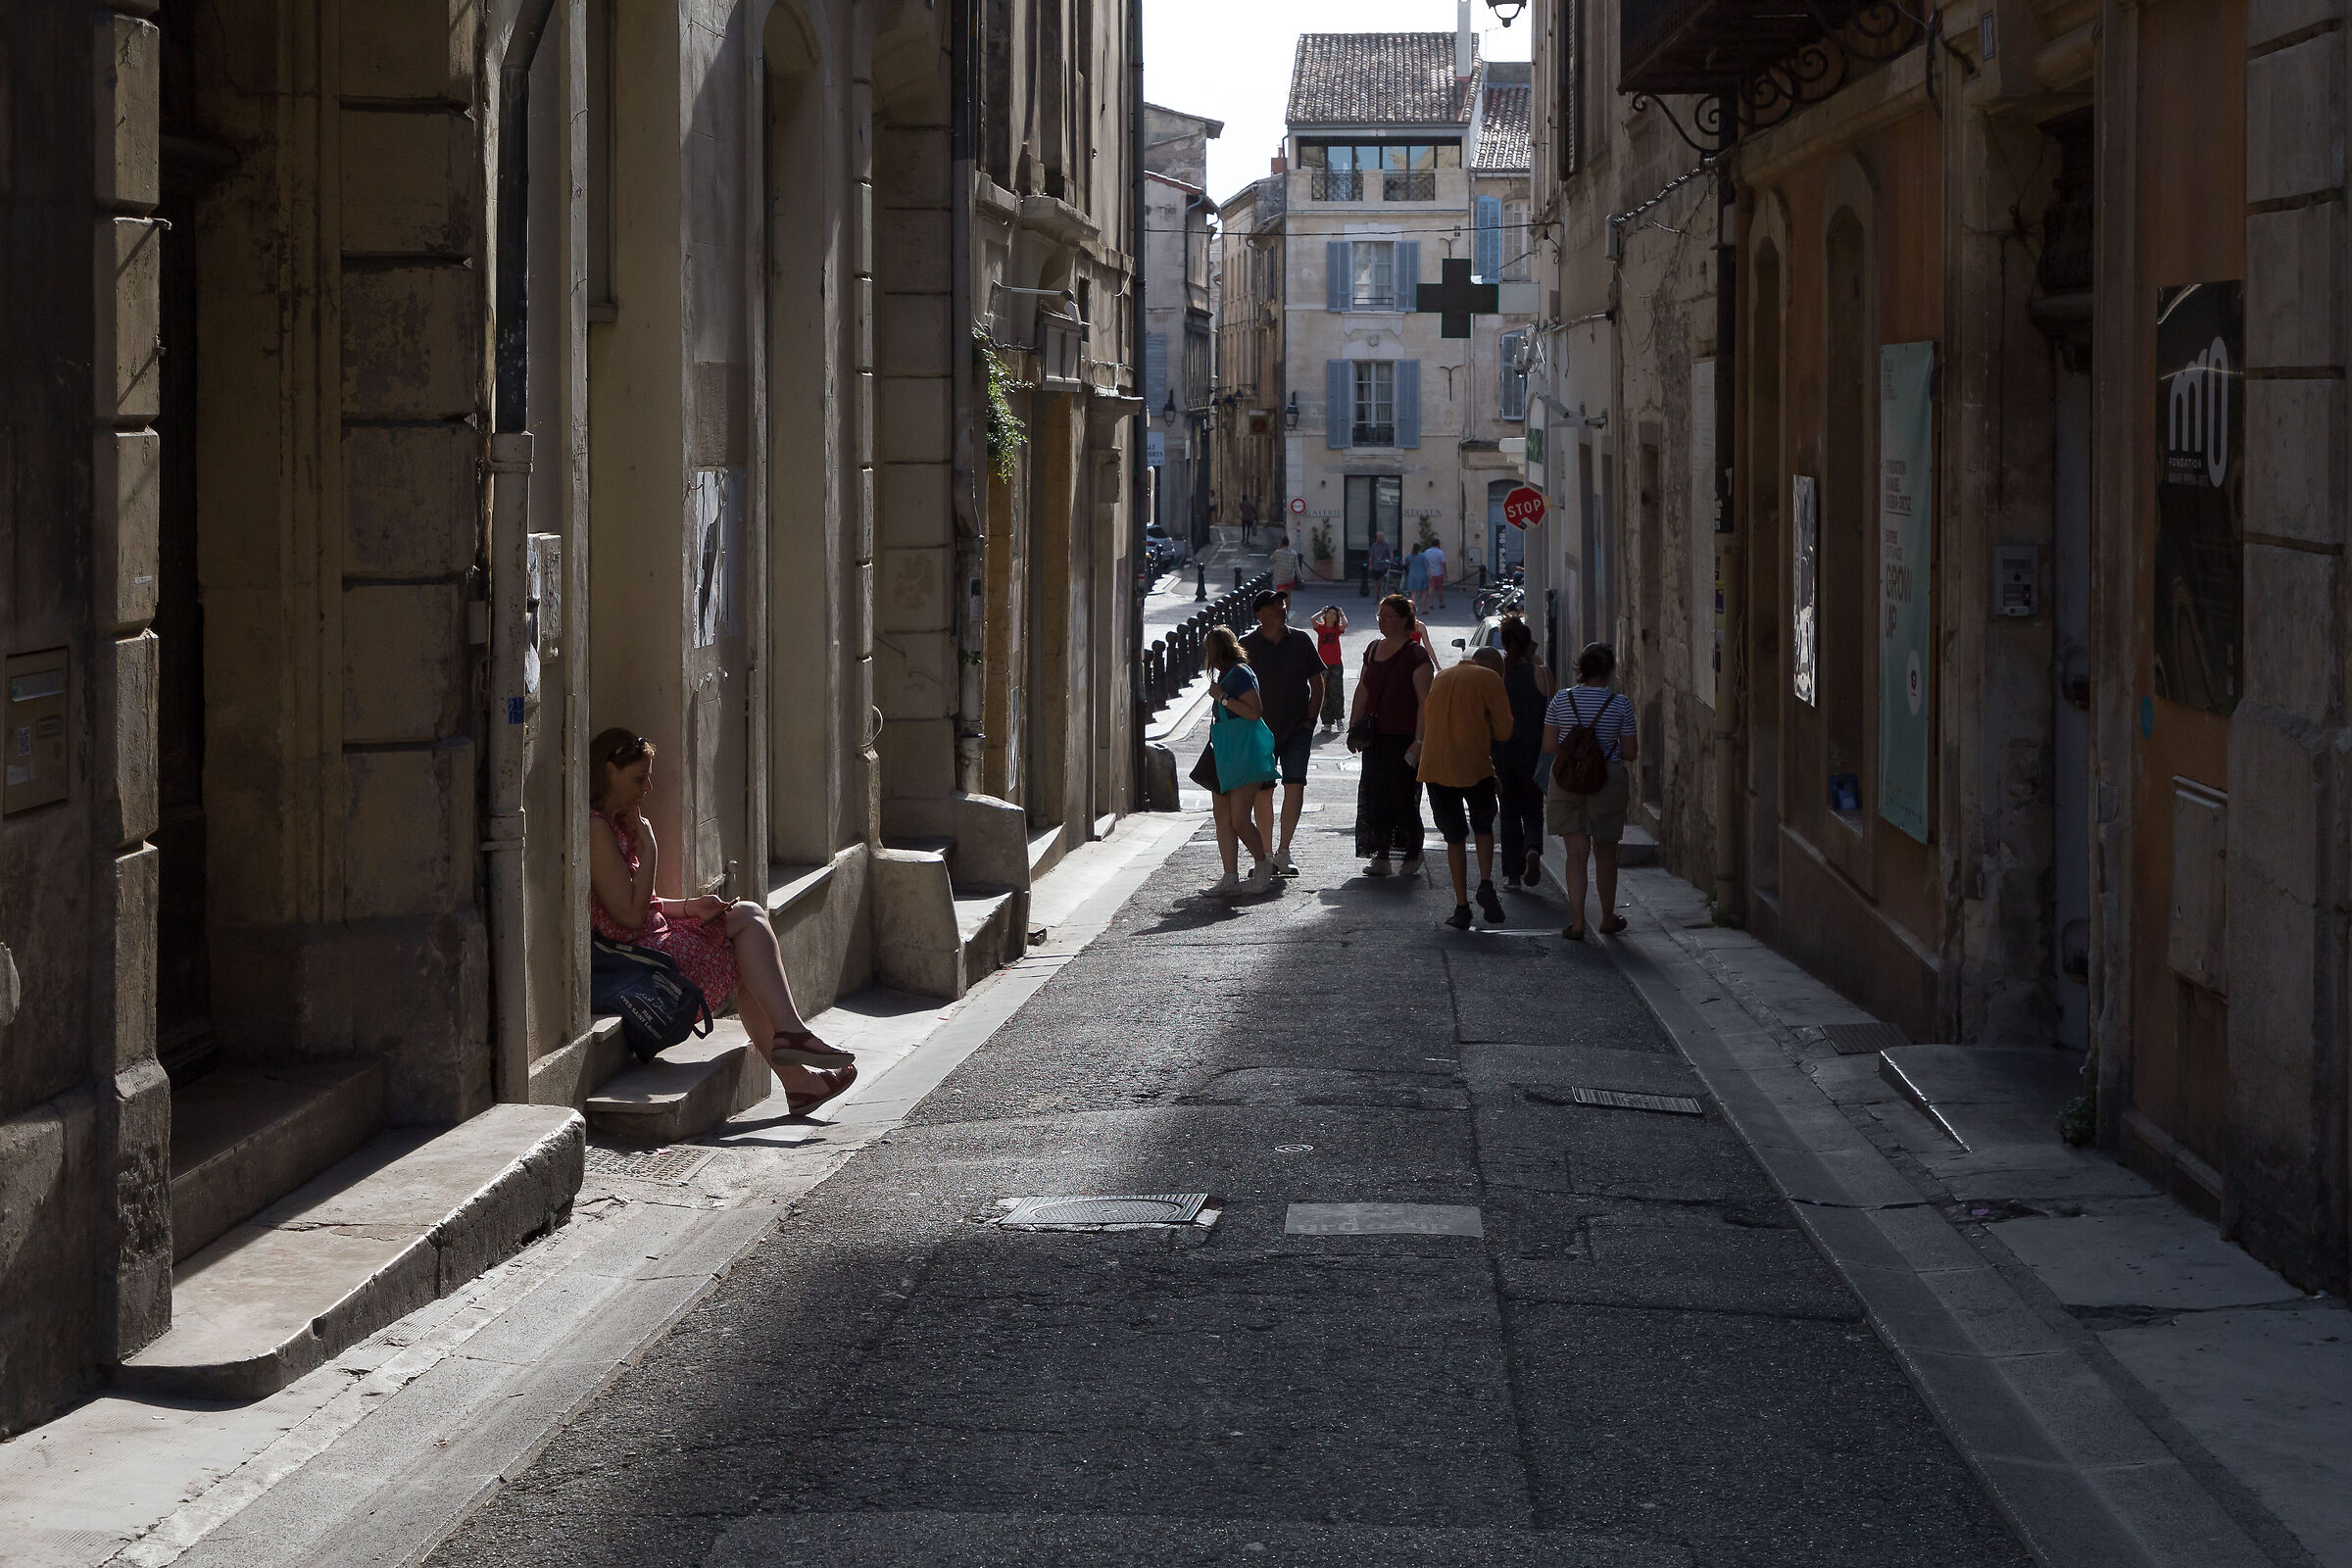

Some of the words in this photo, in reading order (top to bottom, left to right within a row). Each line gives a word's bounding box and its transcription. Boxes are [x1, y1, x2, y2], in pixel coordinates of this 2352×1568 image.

[1506, 498, 1542, 518] STOP
[1886, 563, 1914, 605] GROW
[1886, 602, 1897, 640] UP
[631, 1007, 646, 1023] SAINT
[642, 1009, 654, 1022] RUE
